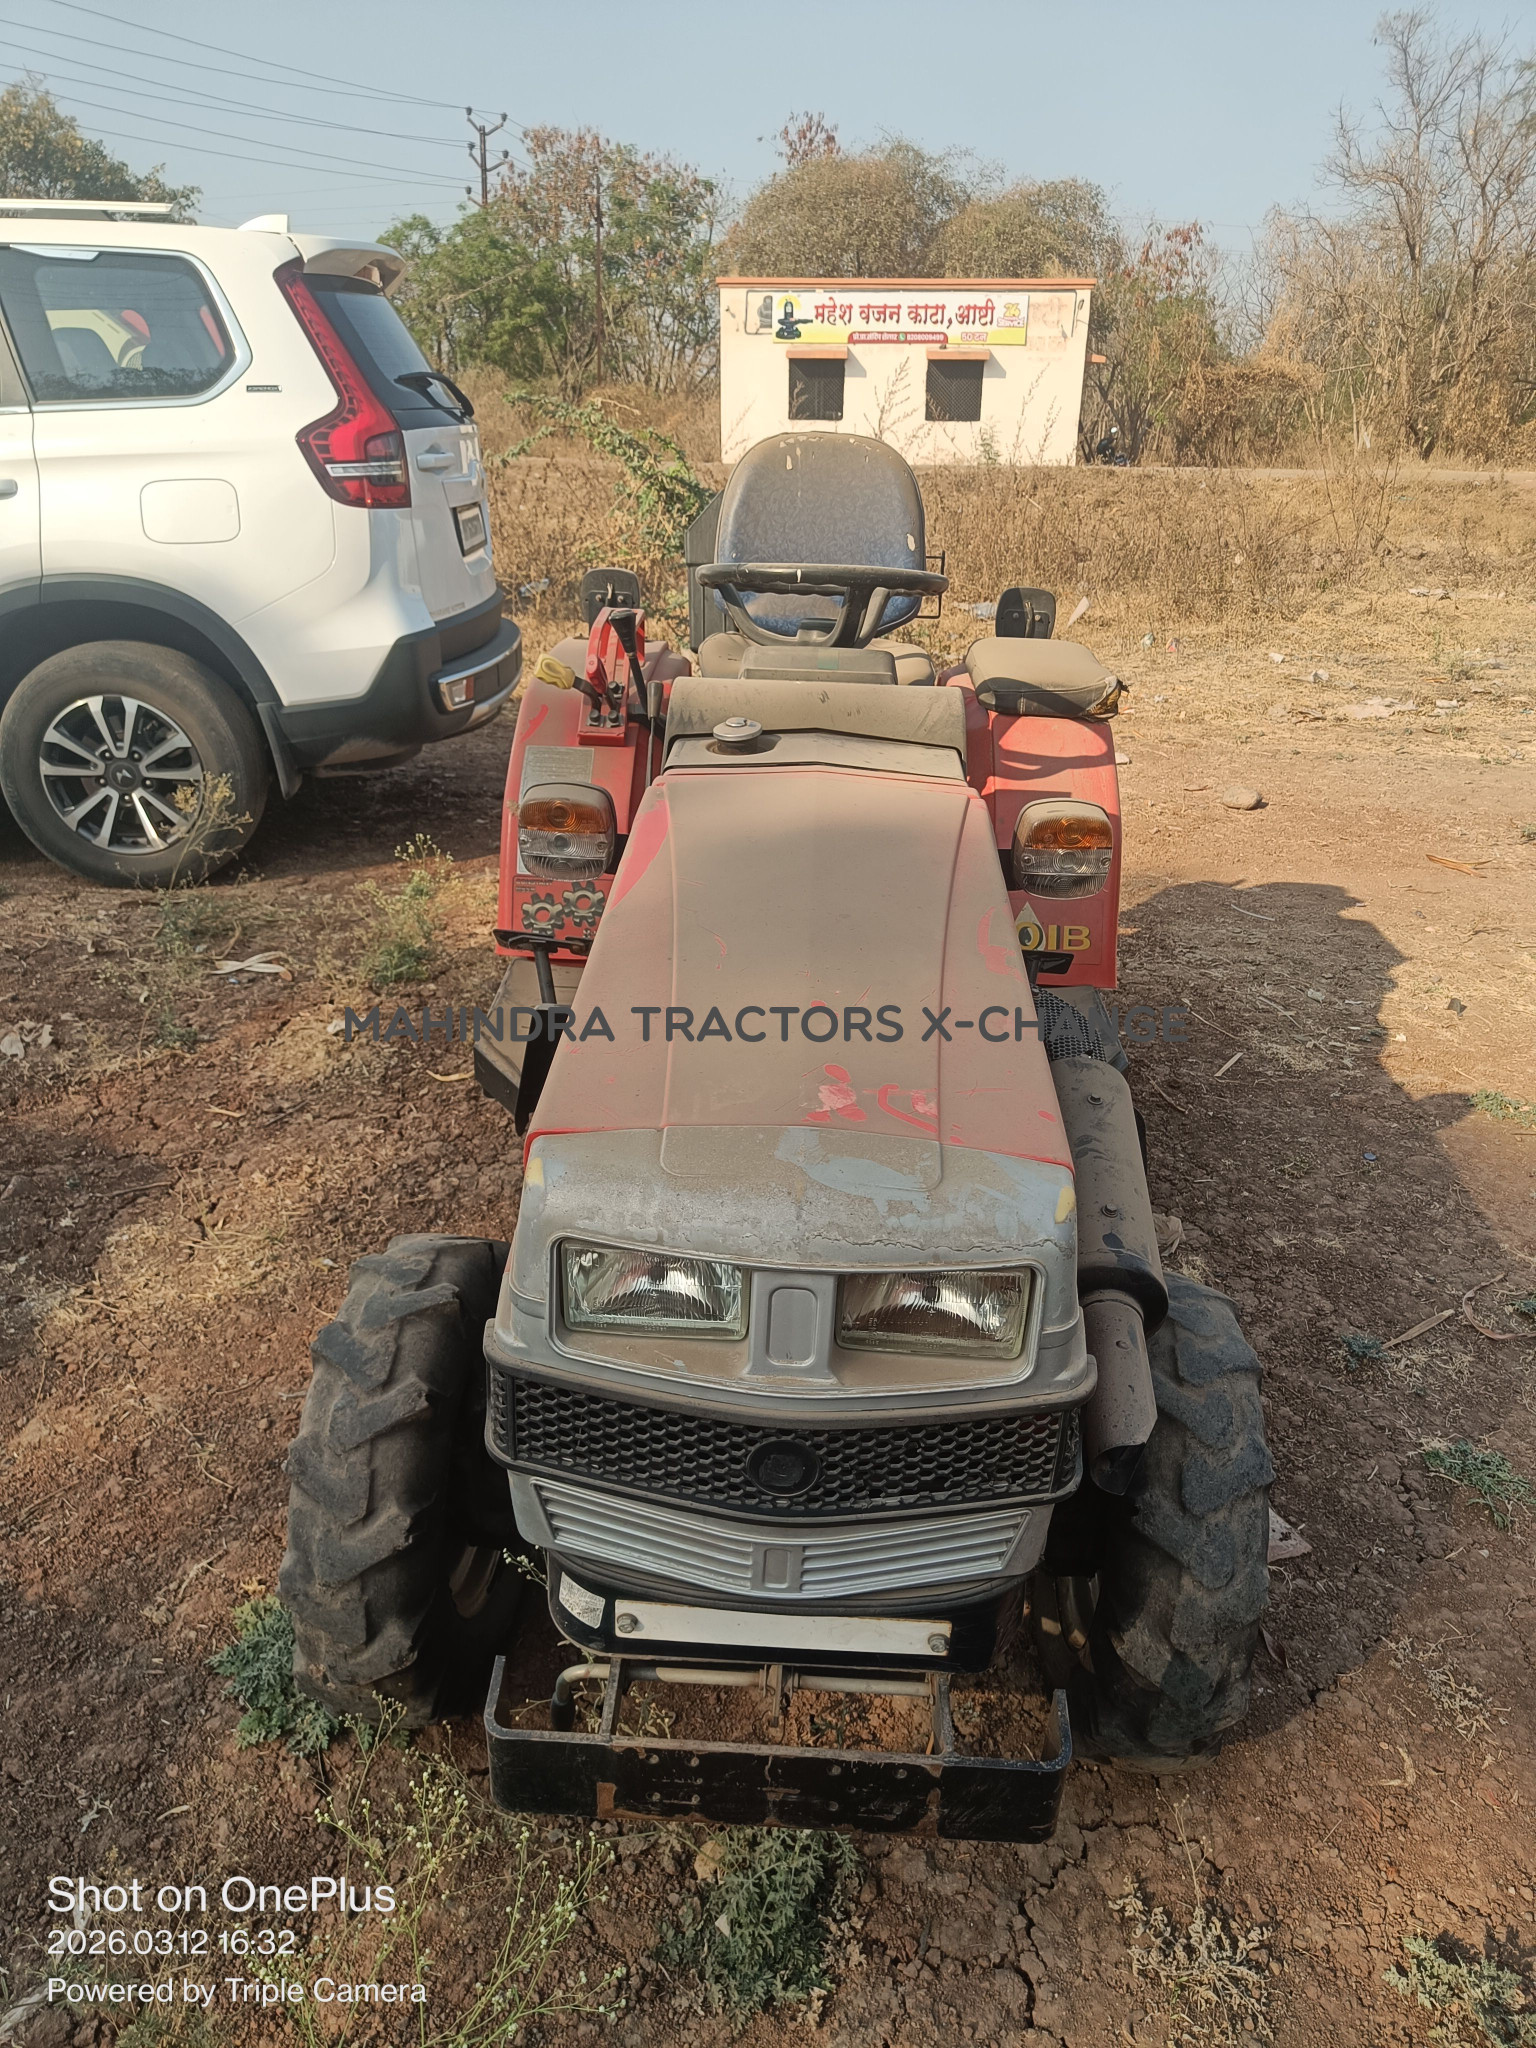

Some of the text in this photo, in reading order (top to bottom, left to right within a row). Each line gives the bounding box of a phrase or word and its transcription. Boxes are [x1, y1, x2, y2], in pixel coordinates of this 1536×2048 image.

[814, 296, 854, 326] महेश
[859, 303, 902, 325] वजन
[974, 332, 989, 342] टन
